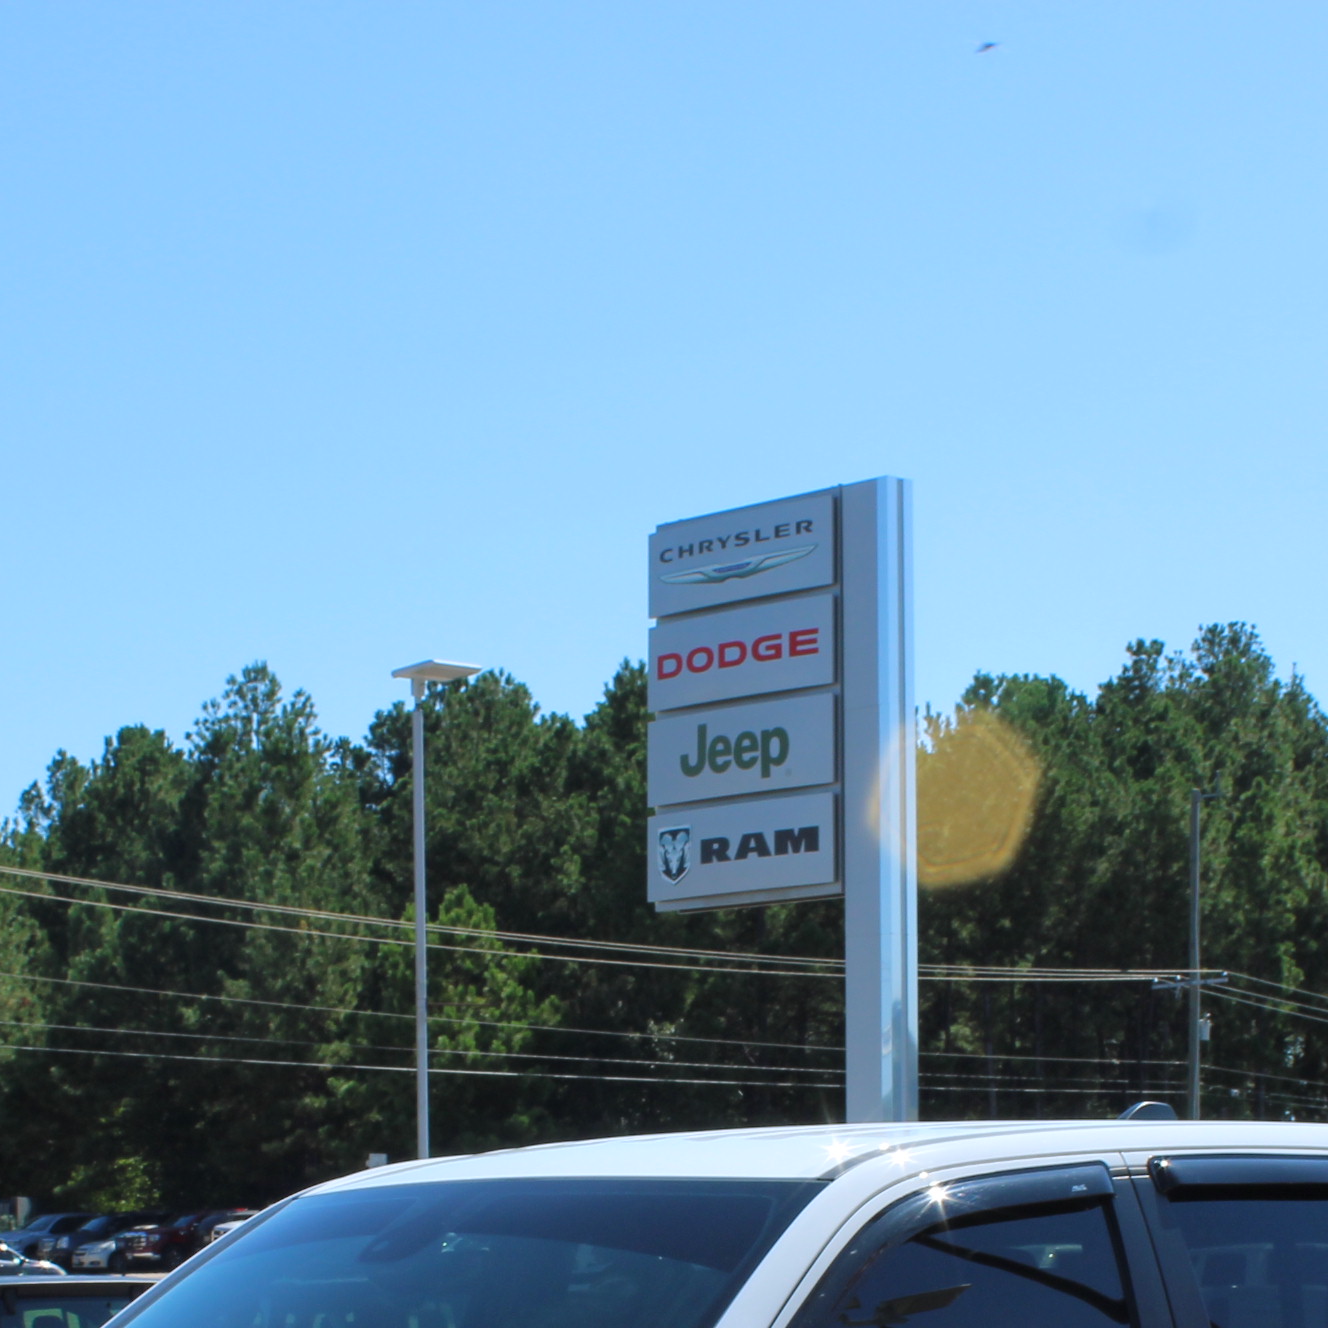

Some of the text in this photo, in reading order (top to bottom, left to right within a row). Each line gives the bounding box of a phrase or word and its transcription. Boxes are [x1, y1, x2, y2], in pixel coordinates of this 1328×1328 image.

[659, 518, 814, 564] CHRYSLER
[656, 627, 820, 680] DODGE
[680, 723, 790, 779] Jeep
[700, 825, 820, 865] RAM
